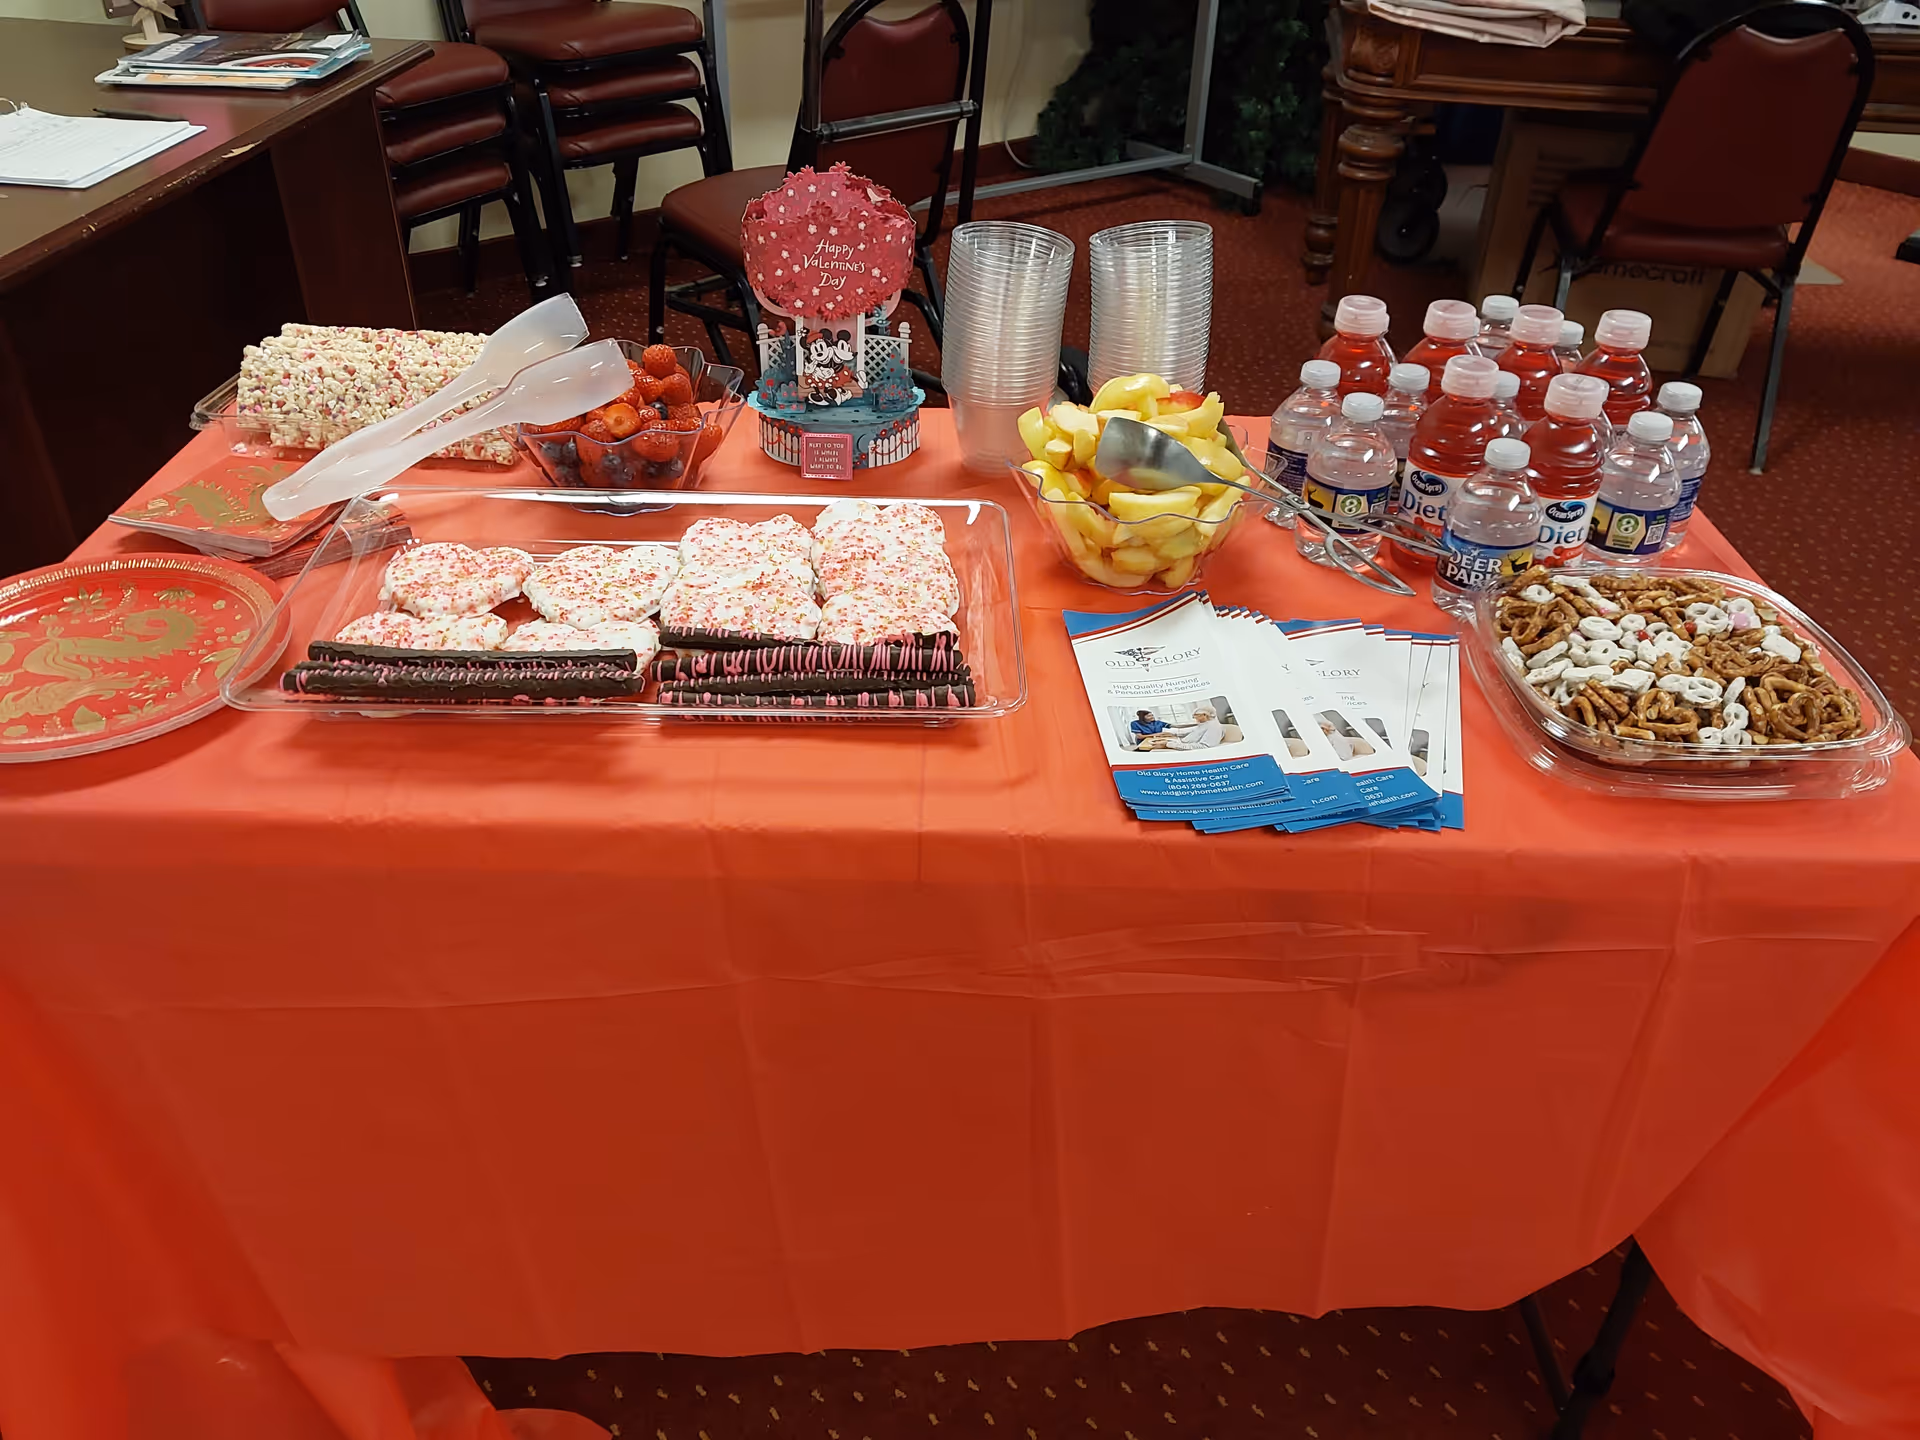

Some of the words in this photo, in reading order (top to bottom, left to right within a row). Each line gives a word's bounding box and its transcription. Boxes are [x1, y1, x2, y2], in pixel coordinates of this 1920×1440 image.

[814, 239, 854, 260] Happy
[819, 271, 847, 290] Day
[1411, 474, 1426, 491] Ocean
[1424, 483, 1443, 493] Spray
[1403, 489, 1447, 522] Diet
[1548, 506, 1567, 520] Ocean
[1566, 507, 1584, 520] Spray
[1537, 525, 1584, 545] Diet
[1105, 660, 1136, 668] OLD
[1153, 647, 1201, 665] GLORY
[1165, 677, 1199, 688] Nursing
[1174, 681, 1211, 691] Services
[1201, 766, 1229, 775] Health
[1230, 762, 1250, 771] Care
[1140, 780, 1264, 796] www.oldgloryhomehealth.com
[1355, 778, 1376, 787] ealth
[1375, 774, 1395, 783] Care
[1359, 785, 1379, 794] Care
